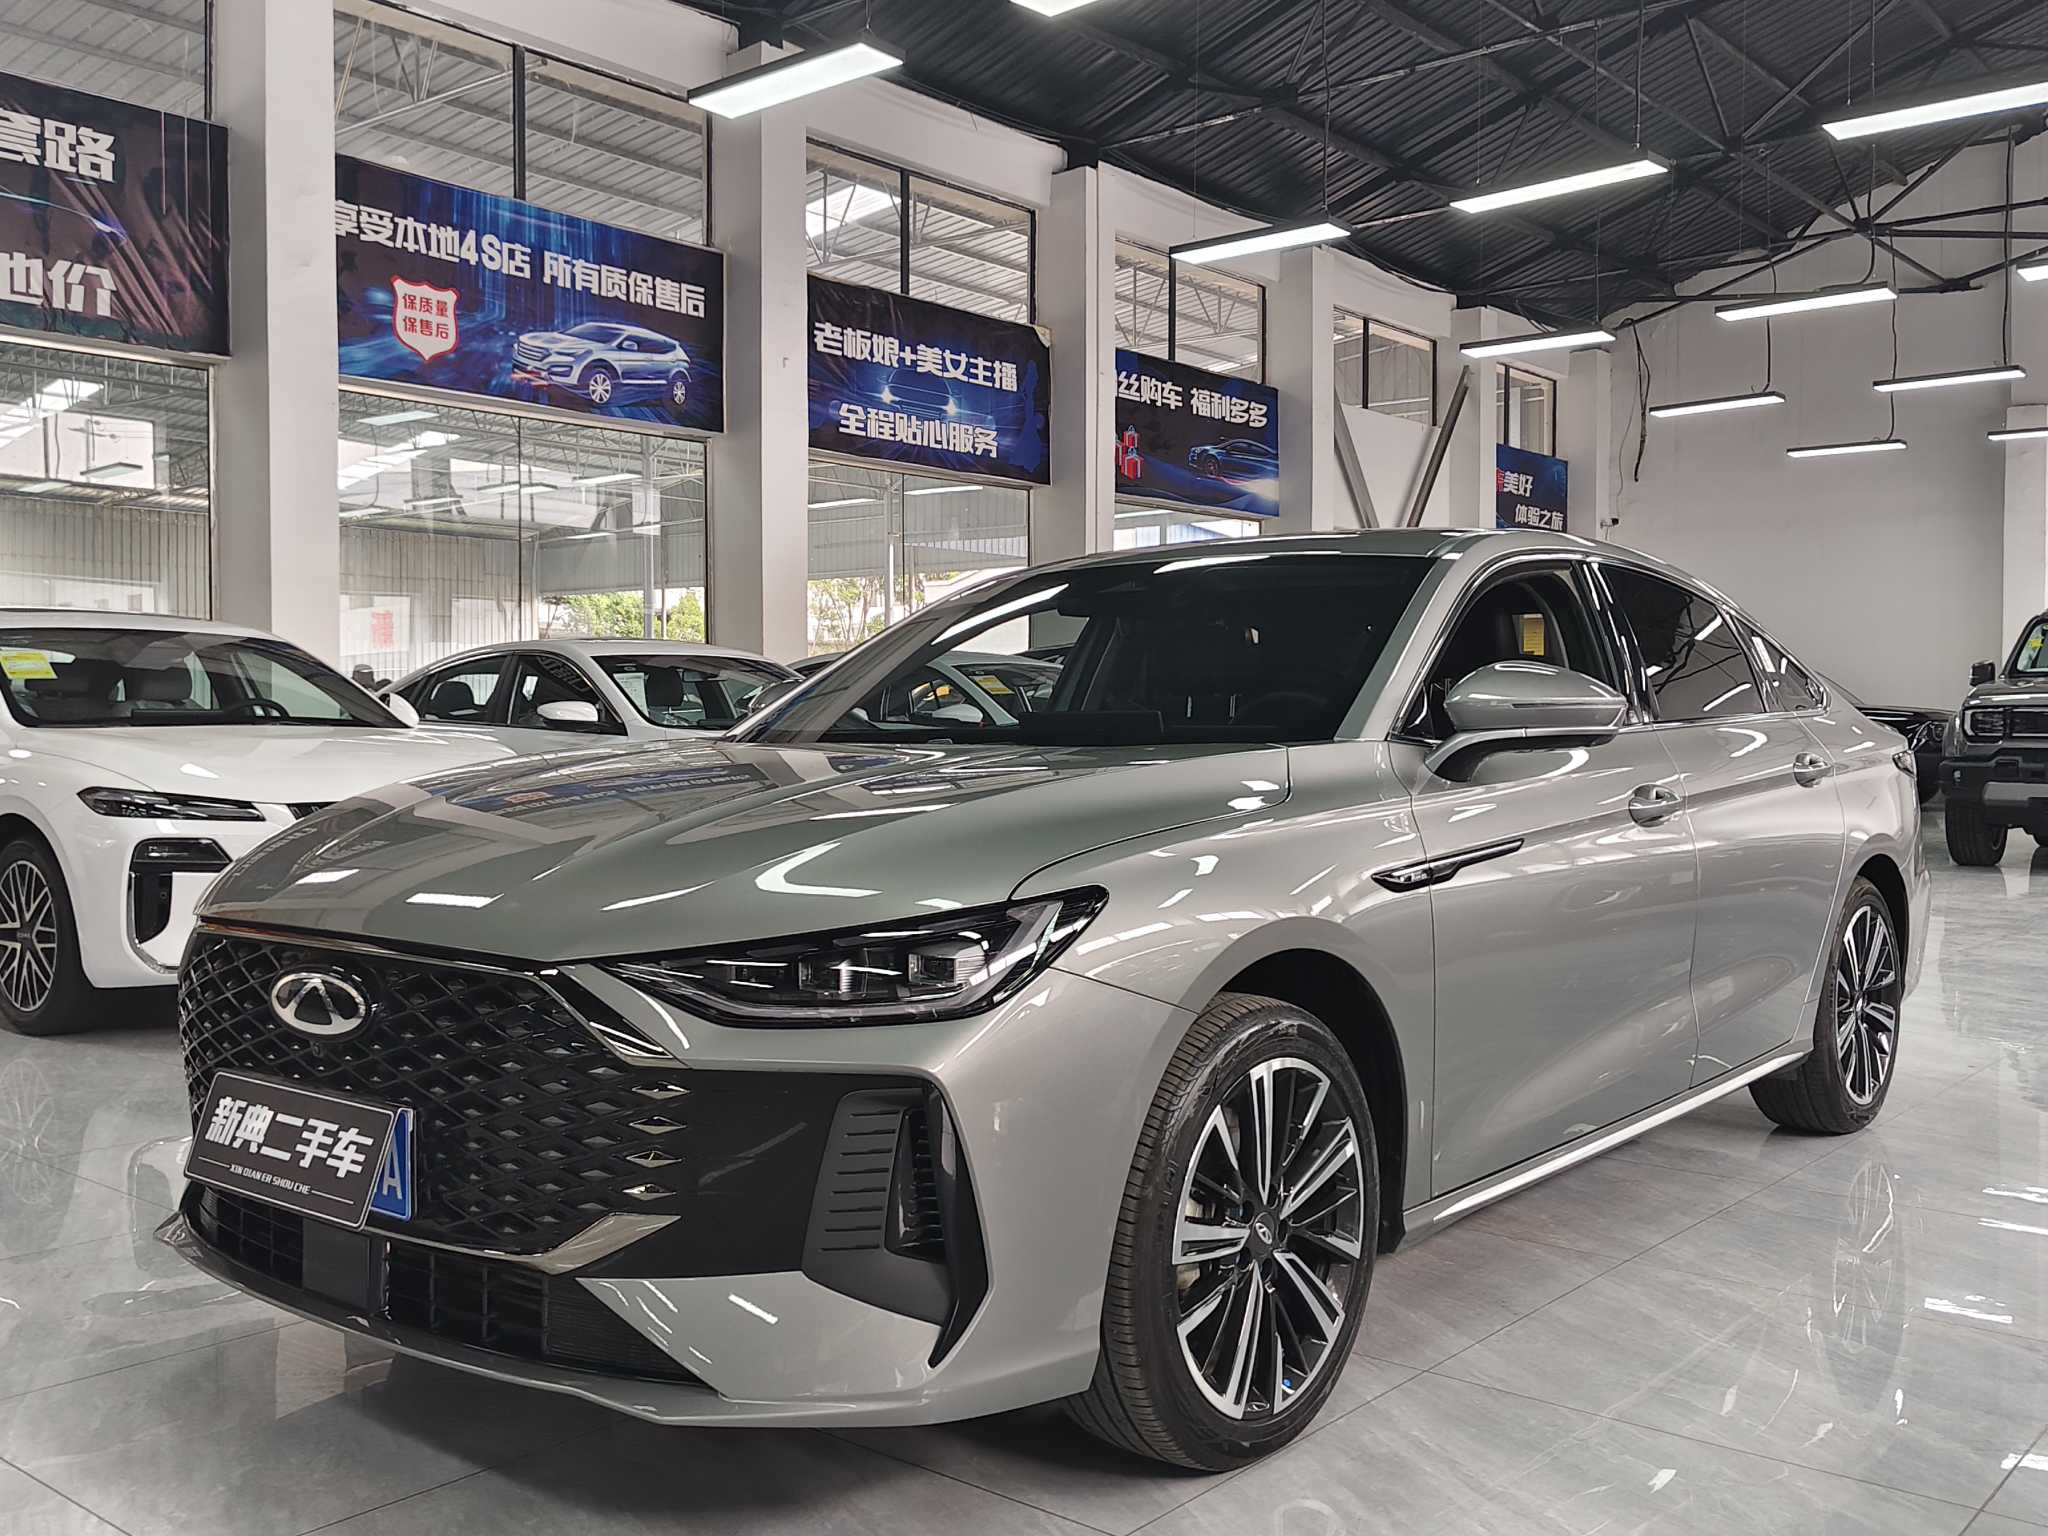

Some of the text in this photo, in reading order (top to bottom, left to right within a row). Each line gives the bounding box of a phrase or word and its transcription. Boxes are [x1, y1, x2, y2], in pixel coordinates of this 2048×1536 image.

[335, 200, 705, 318] 享受本地4S店 所有质保售后
[402, 293, 449, 317] 保质量
[402, 316, 449, 339] 保售后
[814, 322, 1019, 393] 老板娘+美女主播
[1118, 371, 1268, 428] 丝购车 福利多多
[838, 402, 998, 458] 全程贴心服务
[1514, 504, 1564, 530] 体验之旅
[205, 1096, 374, 1178] 新典二手车
[230, 1164, 311, 1195] XIN DIAN ER SHOU CHE
